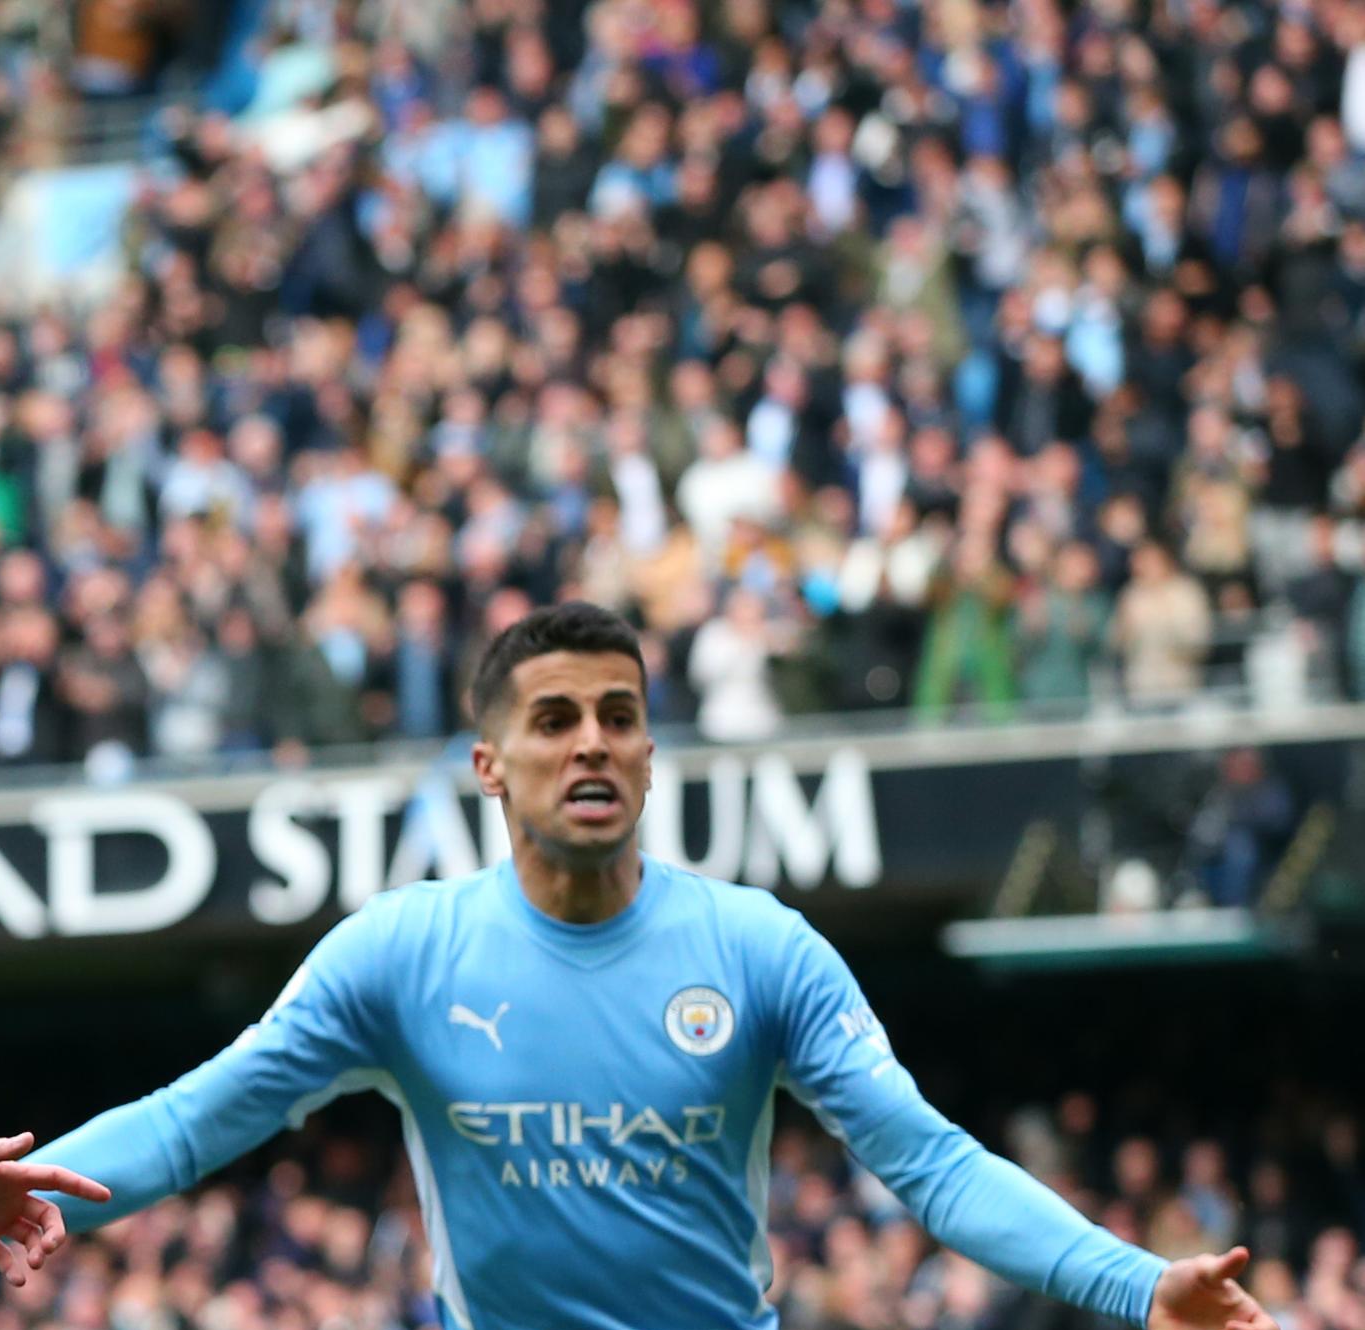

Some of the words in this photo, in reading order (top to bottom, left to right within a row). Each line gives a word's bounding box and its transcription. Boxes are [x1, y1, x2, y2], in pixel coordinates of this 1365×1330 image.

[247, 750, 882, 925] STAUM
[447, 1101, 725, 1147] ETIHAD
[501, 1157, 689, 1189] AIRWAYS
